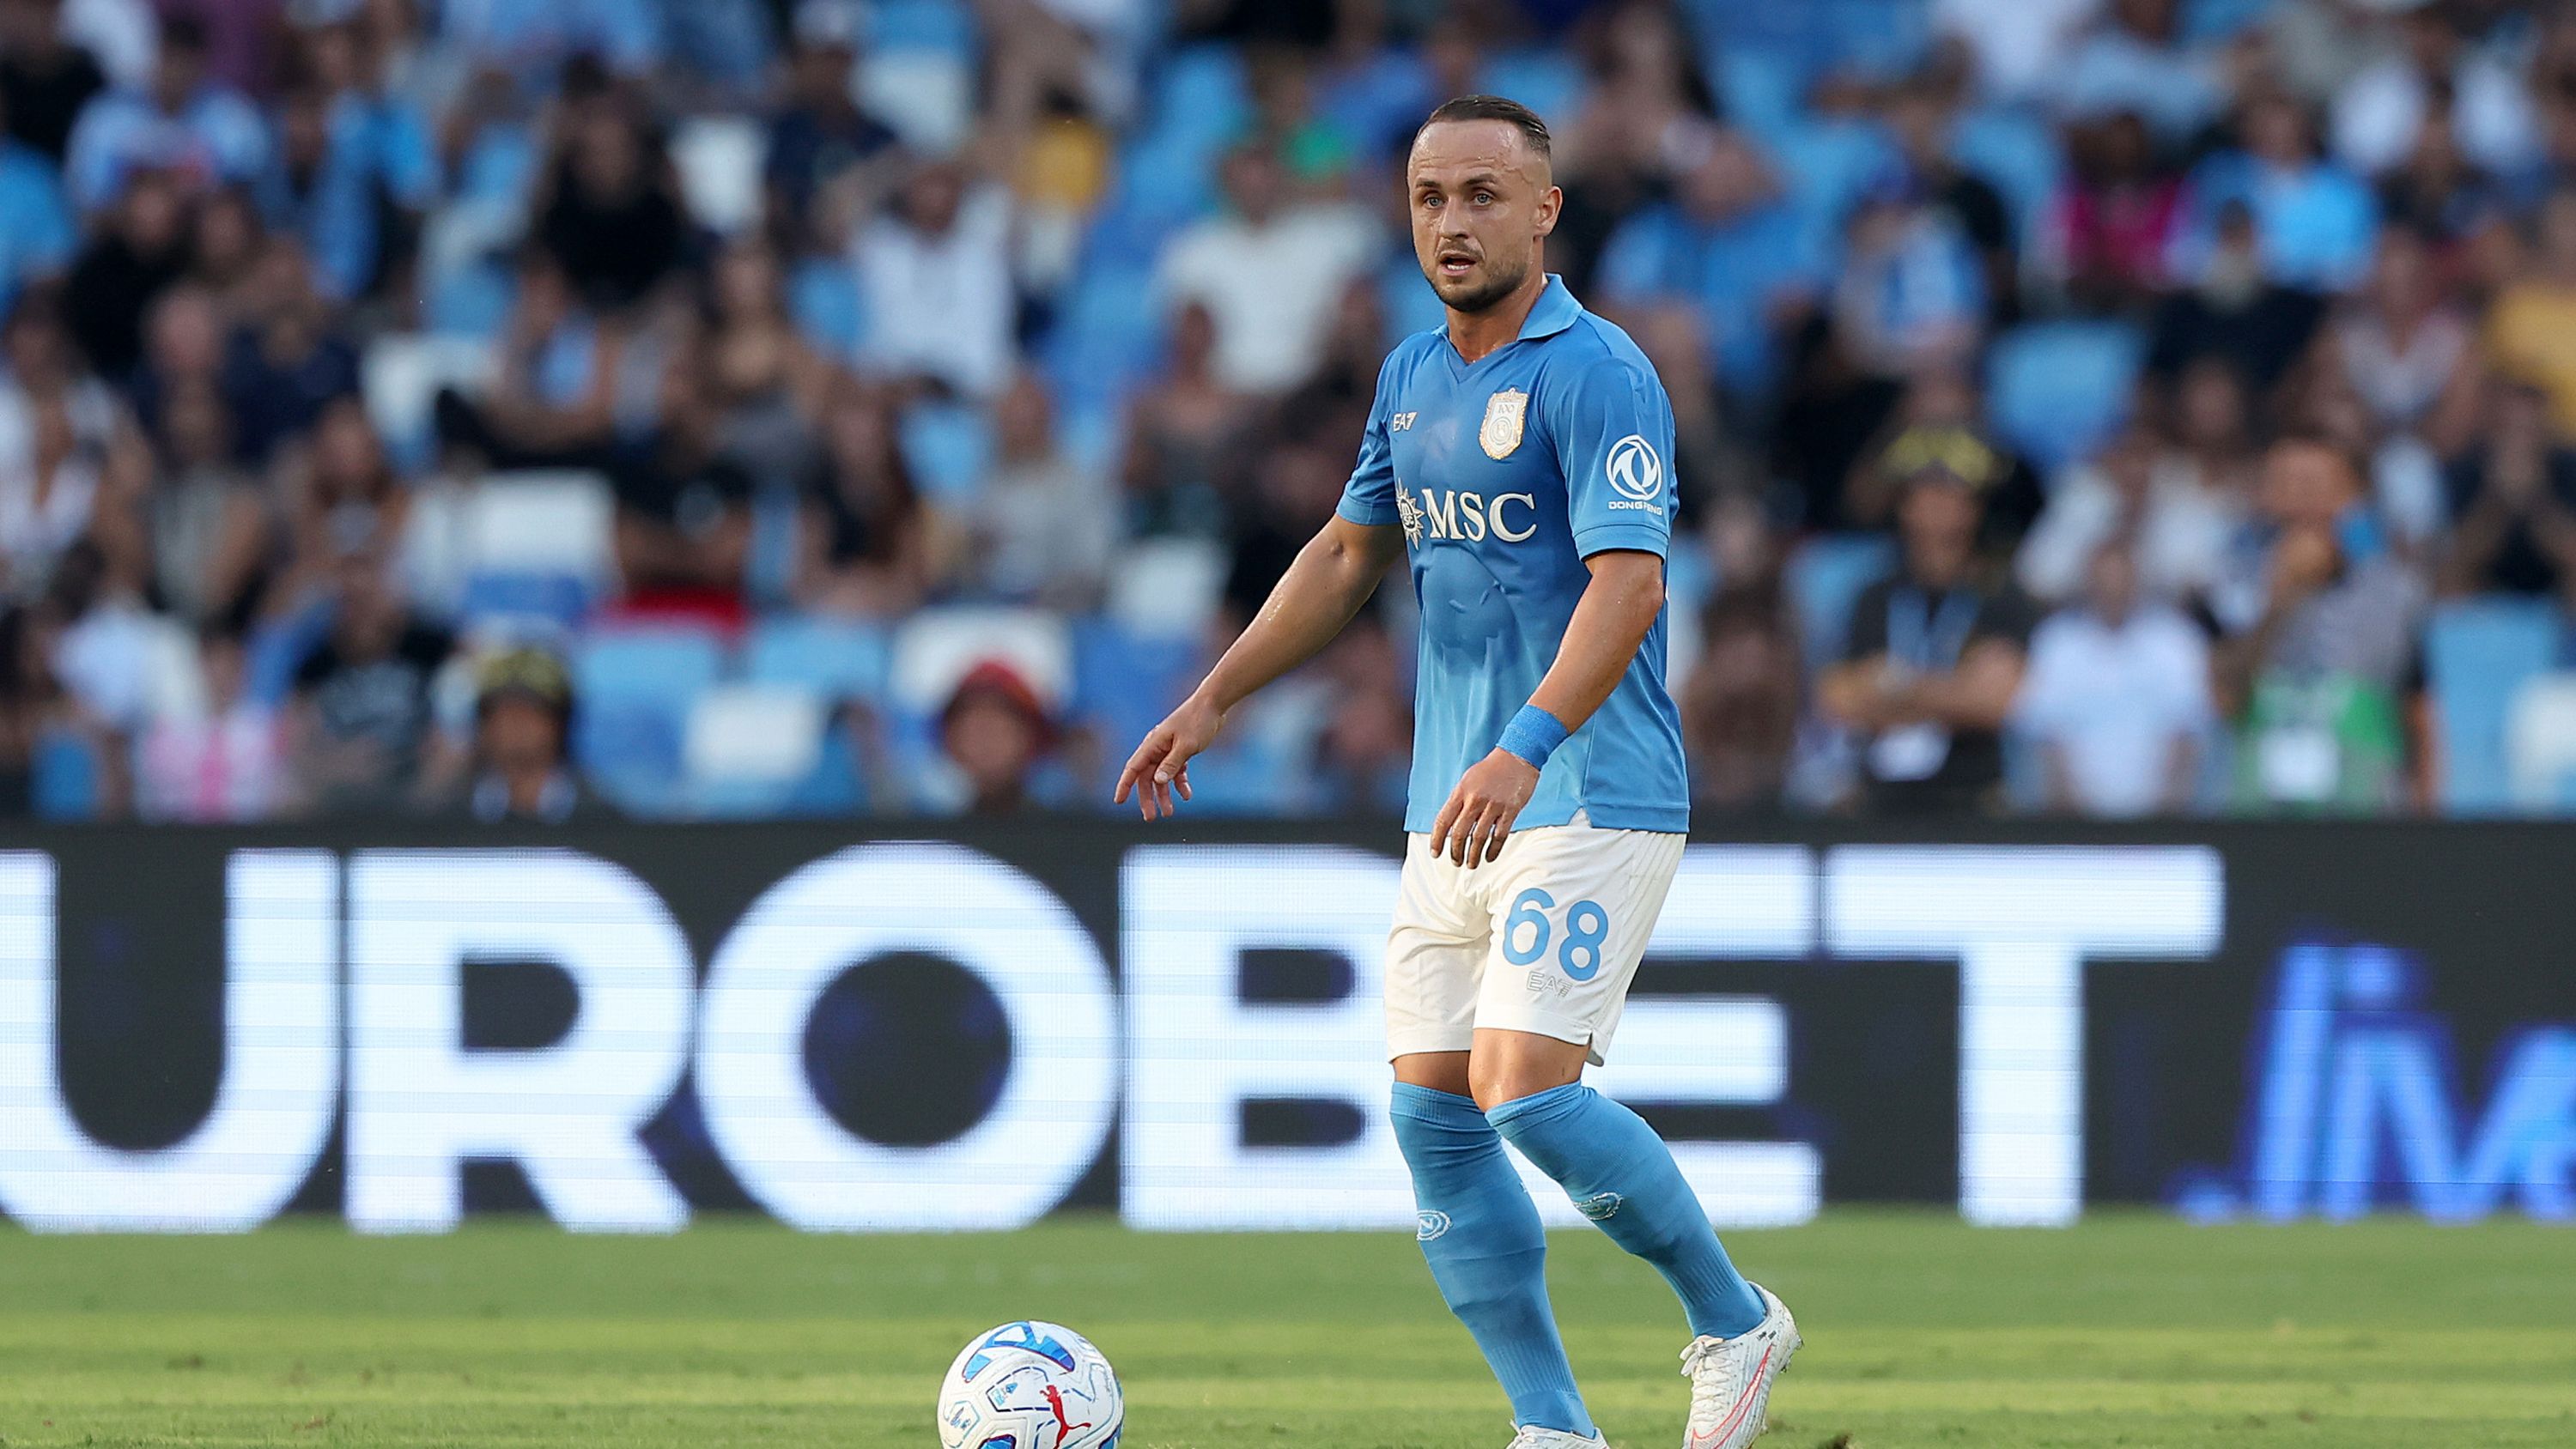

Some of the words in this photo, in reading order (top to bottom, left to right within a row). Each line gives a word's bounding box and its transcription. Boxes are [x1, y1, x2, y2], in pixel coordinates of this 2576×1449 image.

[1394, 411, 1417, 432] EA7
[1421, 488, 1537, 543] MSC
[1608, 500, 1662, 516] DONGFENG
[1503, 888, 1608, 981] 68
